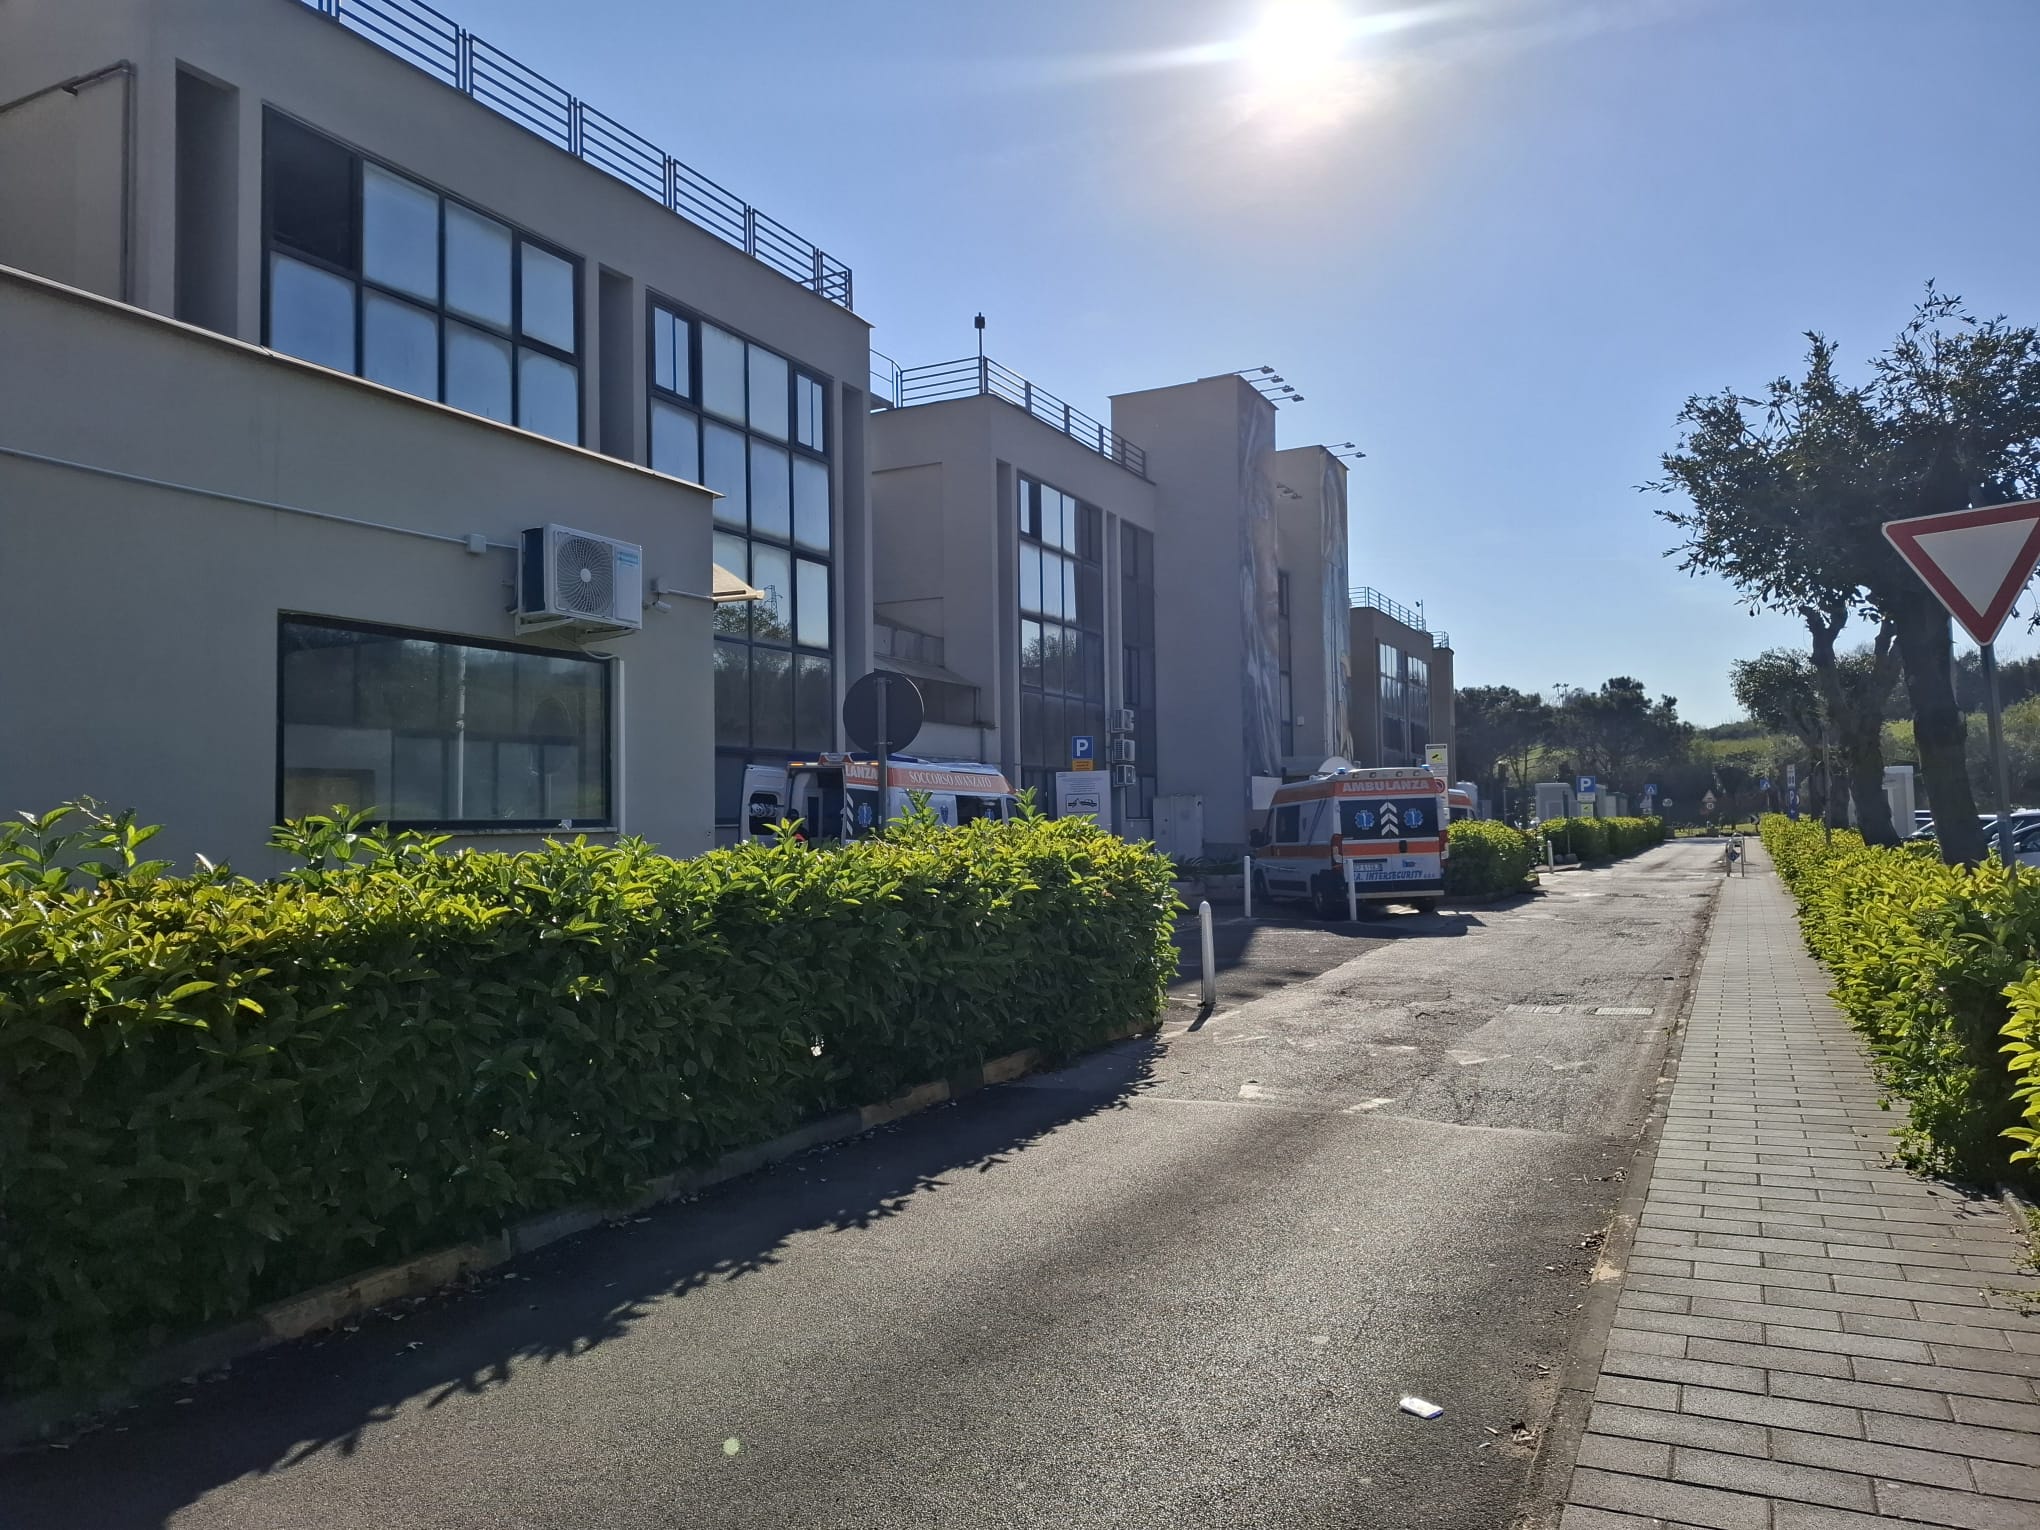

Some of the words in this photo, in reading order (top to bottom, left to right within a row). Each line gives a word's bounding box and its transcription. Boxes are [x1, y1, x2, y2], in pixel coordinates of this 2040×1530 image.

[1076, 738, 1089, 757] P
[908, 770, 953, 786] SOCCORSO
[954, 774, 992, 788] AVANZATO
[1580, 778, 1591, 791] P
[1343, 780, 1429, 792] AMBULANZA
[1366, 870, 1423, 880] INTERSECURITY
